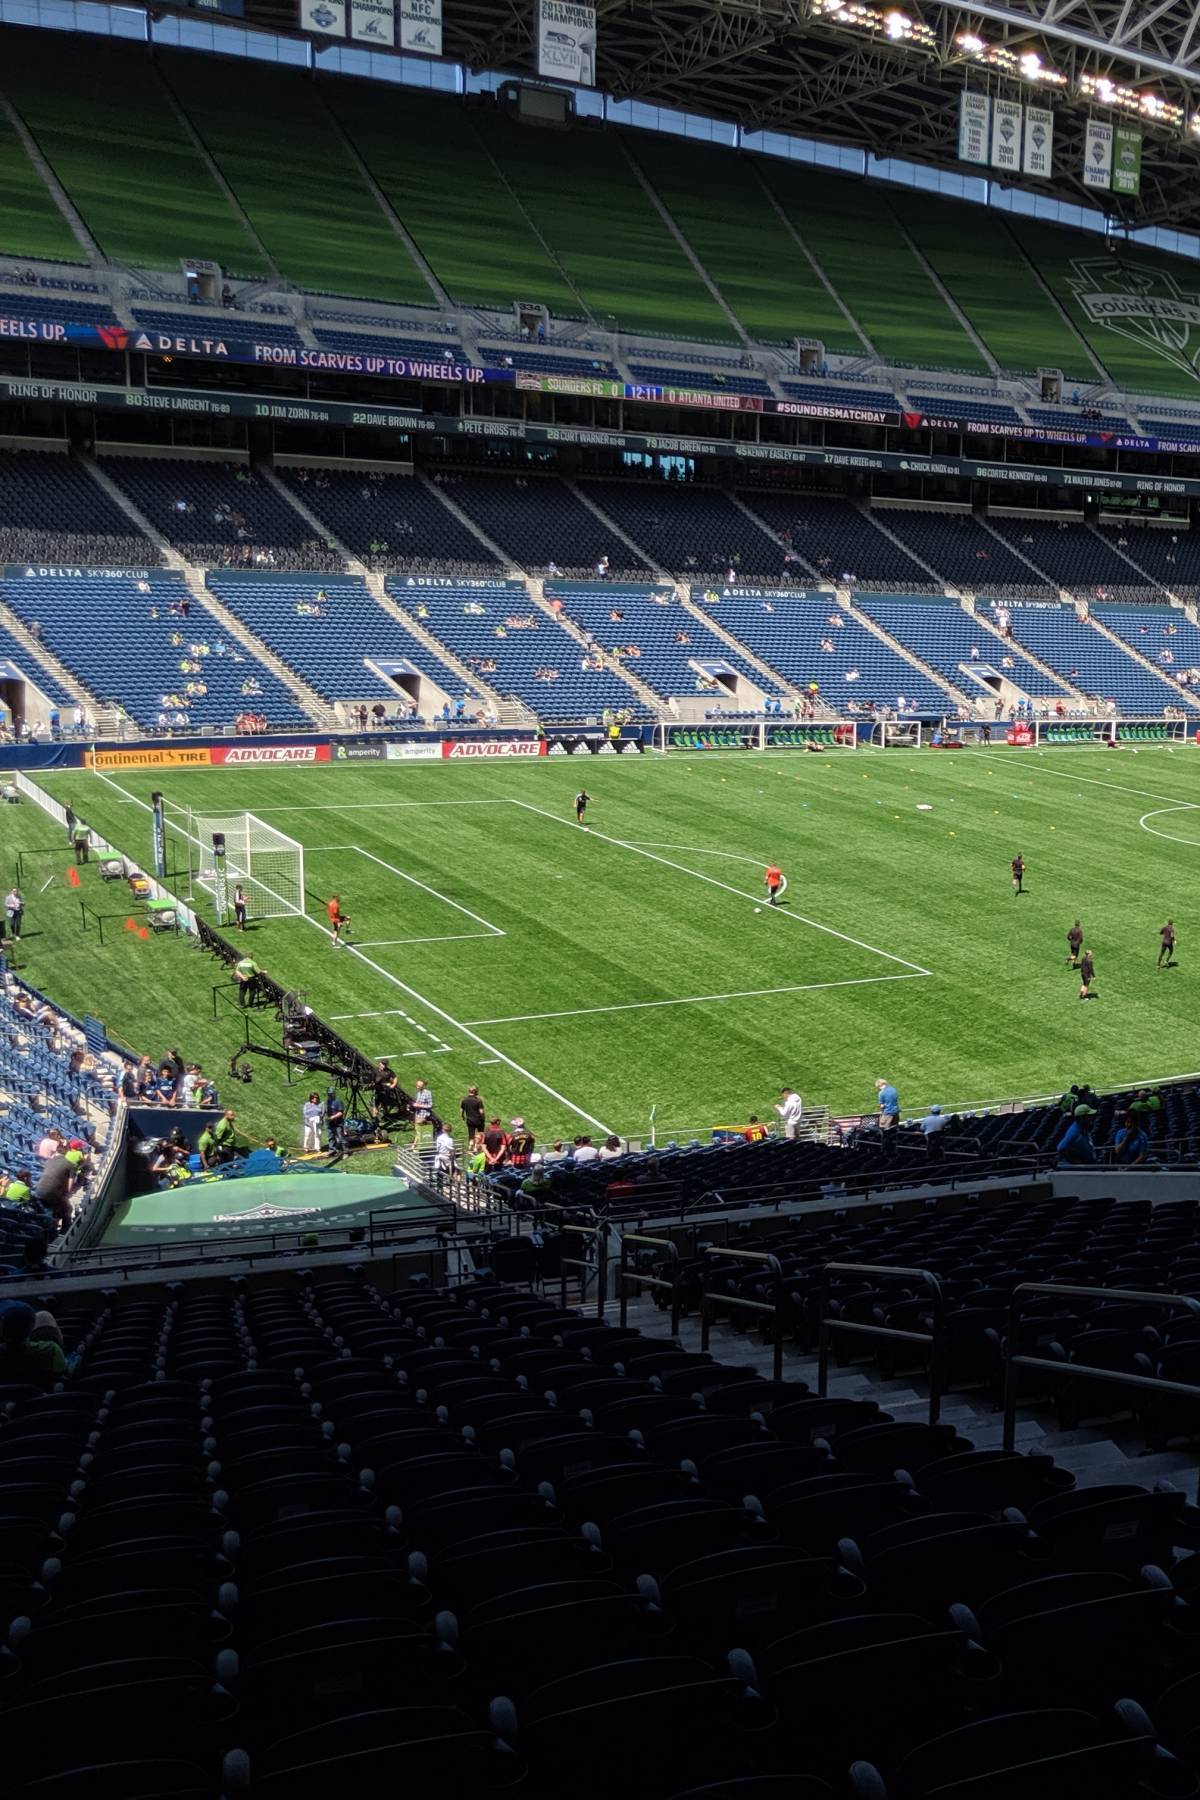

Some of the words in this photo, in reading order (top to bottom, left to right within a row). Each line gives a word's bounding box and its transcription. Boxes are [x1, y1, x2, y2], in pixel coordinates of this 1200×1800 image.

[352, 2, 394, 16] CHAMPIONS
[411, 3, 432, 14] NFC
[542, 1, 563, 13] 2013
[565, 4, 594, 20] WORLD
[402, 11, 441, 25] CHAMPIONS
[542, 12, 594, 29] CHAMPIONS
[996, 106, 1020, 118] CHAMPS
[1089, 130, 1111, 140] SHIELD
[999, 145, 1014, 154] 2009
[1031, 152, 1045, 162] 2011
[186, 260, 214, 271] 332
[520, 302, 542, 312] 334
[1092, 302, 1186, 318] SOUNDERS
[42, 323, 68, 342] UP.
[159, 336, 228, 356] DELTA
[256, 345, 296, 364] FROM
[301, 351, 363, 370] SCARVES
[366, 358, 384, 373] UP
[387, 360, 405, 375] TO
[409, 362, 462, 381] WHEELS
[466, 368, 486, 383] UP.
[9, 384, 38, 398] RING
[42, 387, 55, 399] OF
[59, 389, 97, 403] HONOR
[547, 378, 591, 393] SOUNDERS
[593, 382, 604, 395] FC
[612, 385, 618, 396] 0
[632, 386, 656, 400] 12:11
[126, 395, 142, 406] 80
[144, 396, 169, 409] STEVE
[171, 399, 209, 411] LARGENT
[669, 391, 675, 402] 0
[679, 391, 712, 405] ATLANTA
[714, 394, 740, 408] UNITED
[256, 405, 269, 416] 10
[270, 406, 286, 417] JIM
[288, 408, 310, 419] ZORN
[777, 402, 886, 423] #SOUNDERSMATCHDAY
[353, 413, 367, 423] 22
[367, 415, 386, 426] DAVE
[389, 416, 417, 428] BROWN
[930, 419, 958, 429] DELTA
[464, 423, 482, 434] PETE
[484, 424, 509, 437] GROSS
[967, 422, 989, 434] FROM
[990, 424, 1023, 437] SCARVES
[1024, 428, 1035, 438] UP
[1036, 429, 1045, 439] TO
[1046, 431, 1075, 442] WHEELS
[1076, 434, 1087, 444] UP.
[548, 430, 559, 440] 28
[560, 432, 578, 442] CURT
[579, 433, 609, 445] WARNER
[1124, 438, 1150, 448] DELTA
[646, 439, 658, 449] 79
[659, 440, 678, 450] JACOB
[680, 441, 701, 452] GREEN
[1157, 441, 1178, 451] FROM
[736, 448, 747, 456] 45
[747, 448, 769, 459] KENNY
[770, 450, 792, 460] EASLEY
[824, 454, 833, 463] 17
[834, 455, 849, 465] DAVE
[850, 456, 869, 467] KRIEG
[911, 461, 930, 472] CHUCK
[932, 464, 947, 473] KNOX
[976, 468, 987, 477] 96
[987, 469, 1008, 479] CORTEZ
[1009, 471, 1034, 481] KENNEDY
[1064, 475, 1072, 483] 71
[1072, 476, 1092, 486] WALTER
[1093, 477, 1110, 487] JONES
[1137, 481, 1153, 490] RING
[1154, 482, 1162, 491] OF
[1164, 483, 1185, 492] HONOR
[39, 568, 82, 577] DELTA
[225, 746, 316, 762] ADVOCARE
[348, 749, 380, 757] amperity
[450, 742, 541, 757] ADVOCARE
[91, 752, 164, 767] Continental
[179, 752, 207, 762] TIRE
[218, 878, 227, 914] SOUNDERS
[752, 1133, 762, 1141] 10
[518, 1138, 526, 1153] 7
